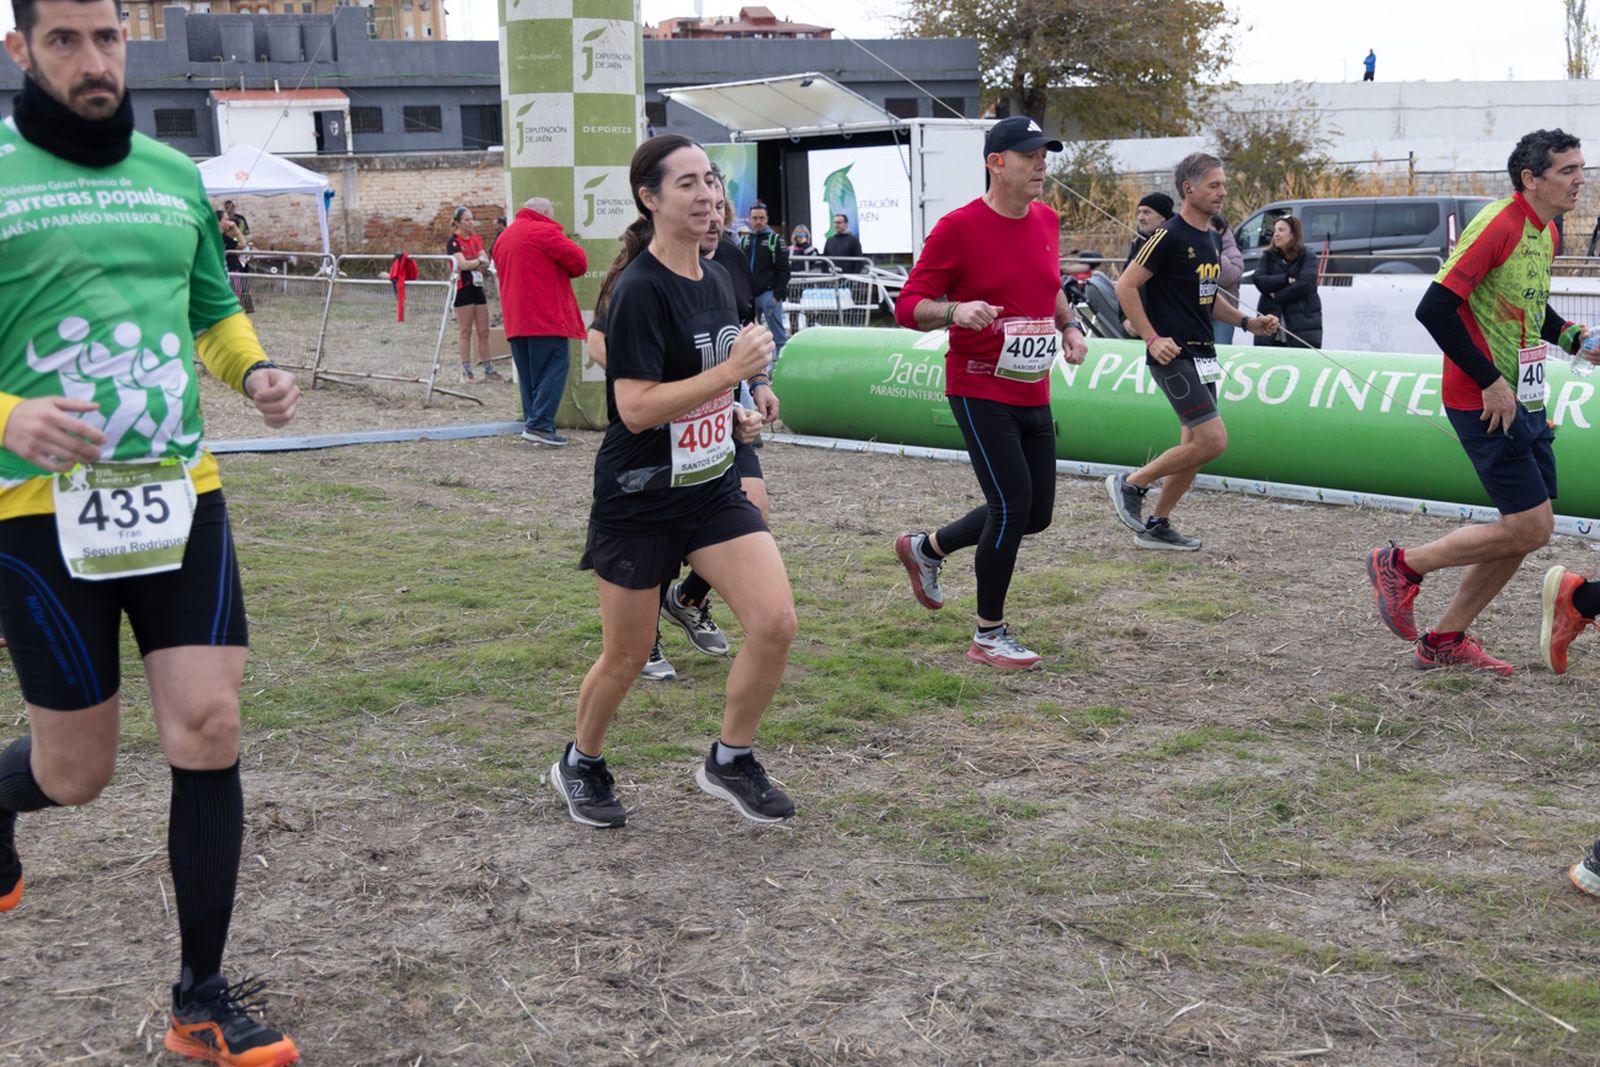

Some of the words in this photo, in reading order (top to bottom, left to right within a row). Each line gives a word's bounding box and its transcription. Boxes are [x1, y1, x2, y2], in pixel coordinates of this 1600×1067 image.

[525, 126, 568, 135] DIPUTACIÓN
[583, 126, 632, 134] DEPORTES
[48, 181, 77, 193] Gran
[79, 179, 118, 189] Premio
[120, 179, 132, 187] de
[96, 187, 188, 211] populares
[597, 208, 606, 216] DE
[608, 206, 624, 216] JAÉN
[42, 210, 101, 230] PARAÍSO
[105, 212, 161, 225] INTERIOR
[1006, 336, 1057, 359] 4024
[882, 353, 943, 388] Jaén
[870, 385, 907, 398] PARAÍSO
[1089, 352, 1299, 405] PAÍSO
[1309, 367, 1592, 429] INTER
[681, 457, 711, 471] SANTOS
[78, 484, 170, 532] 435
[119, 530, 142, 539] Fran
[82, 546, 126, 558] Segura
